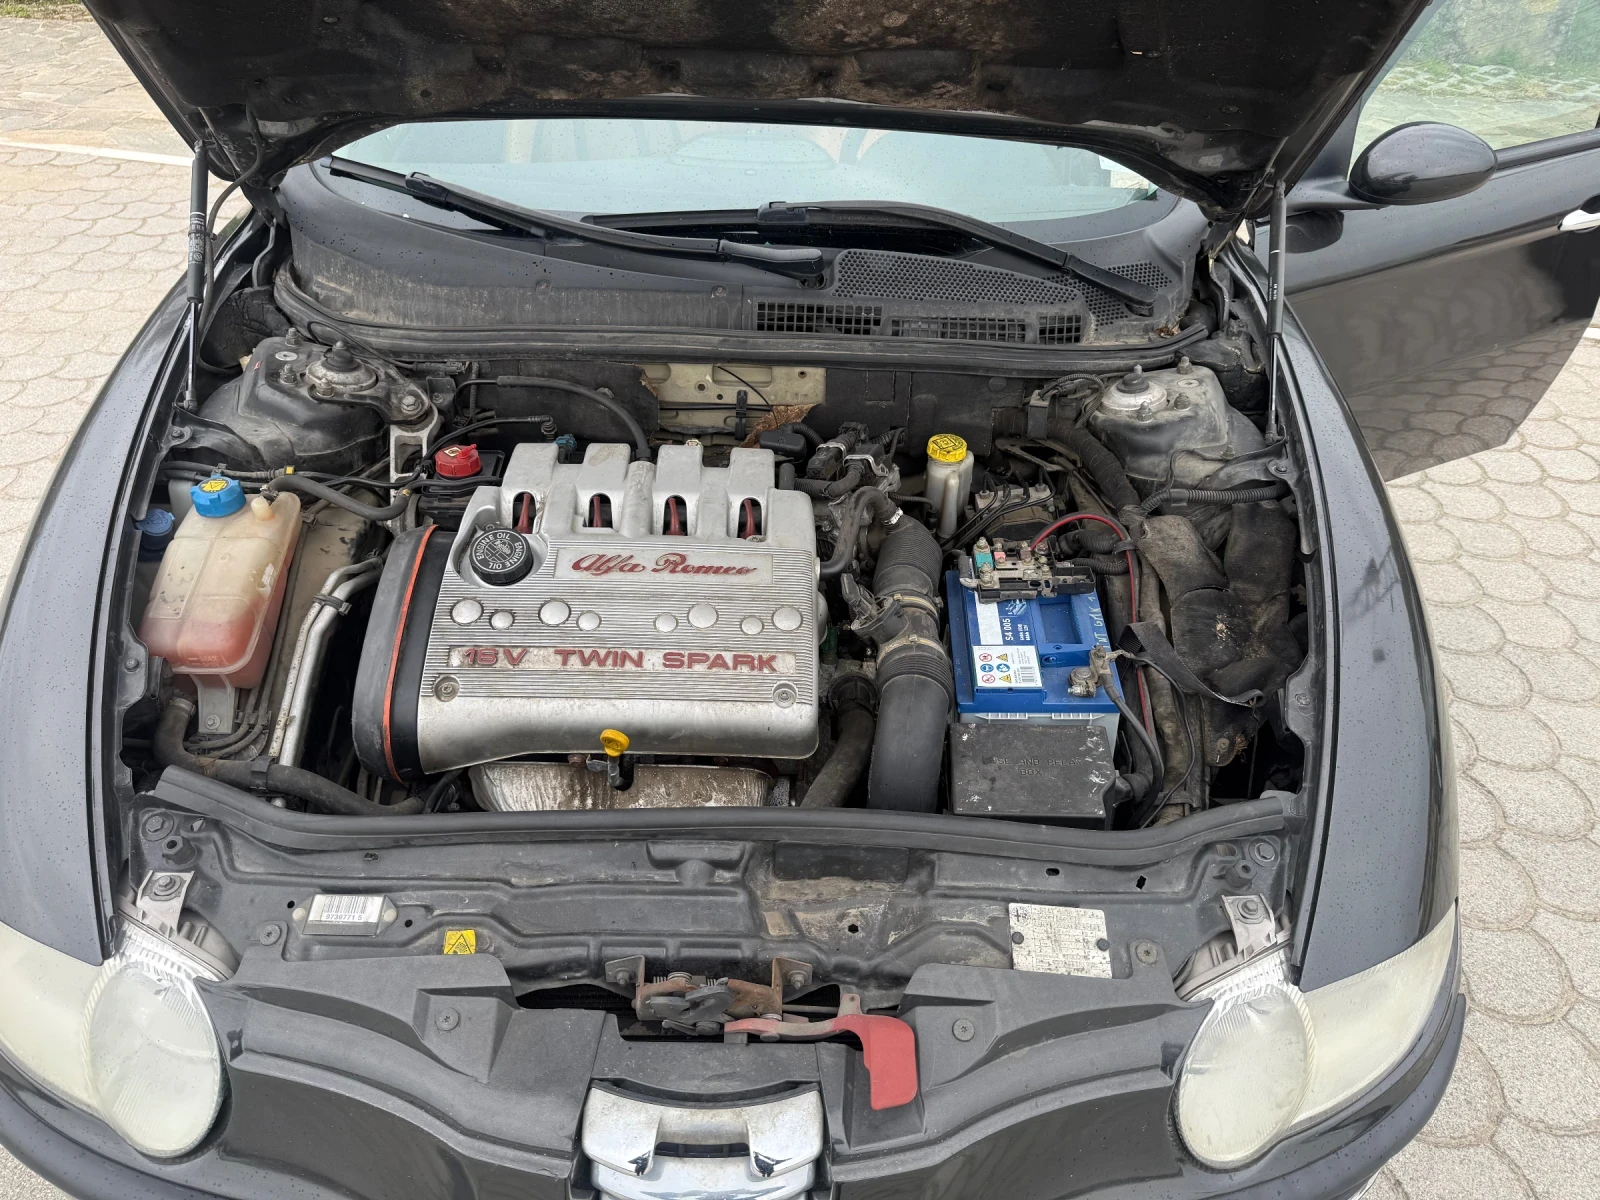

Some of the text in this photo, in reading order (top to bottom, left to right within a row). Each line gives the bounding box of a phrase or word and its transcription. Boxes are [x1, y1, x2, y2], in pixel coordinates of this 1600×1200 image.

[475, 532, 511, 560] ENGINE OIL
[488, 541, 523, 570] ENGINE OIL
[571, 552, 757, 577] Alfa Romeo
[1002, 618, 1014, 641] S4 005
[553, 649, 644, 669] TWIN
[662, 651, 778, 673] SPARK
[1019, 758, 1041, 767] AND
[1020, 768, 1043, 777] BOX
